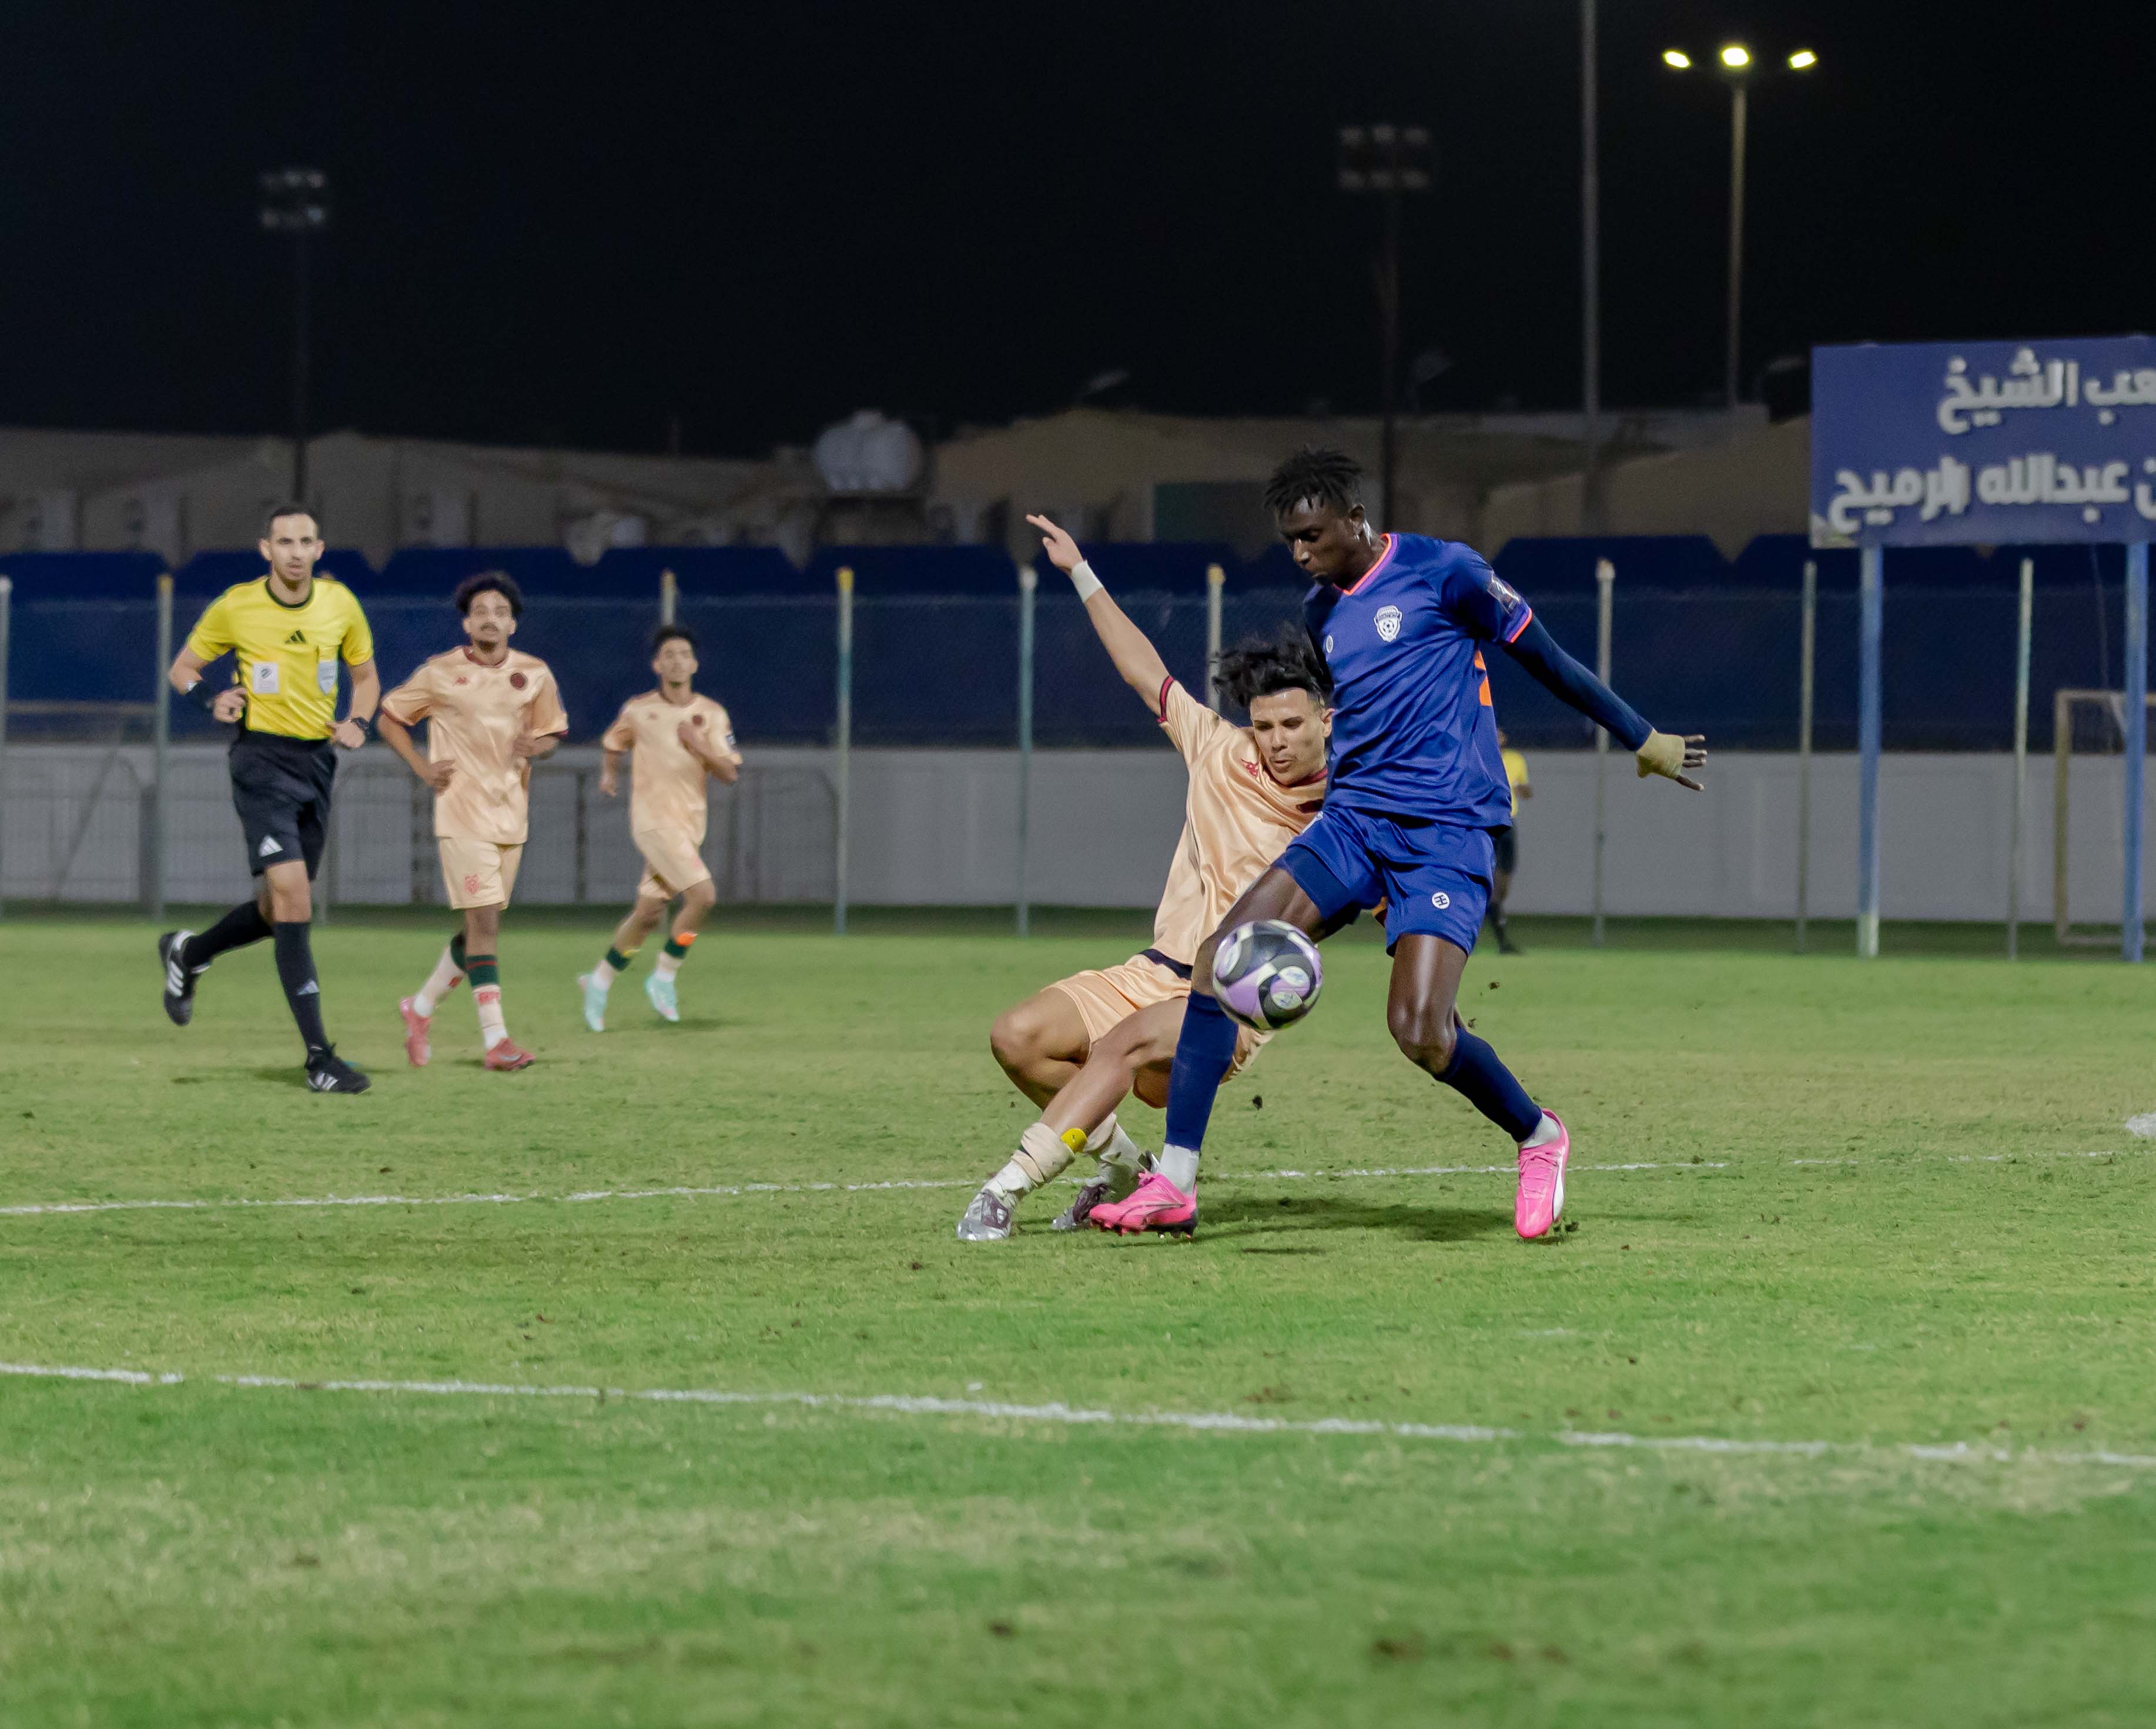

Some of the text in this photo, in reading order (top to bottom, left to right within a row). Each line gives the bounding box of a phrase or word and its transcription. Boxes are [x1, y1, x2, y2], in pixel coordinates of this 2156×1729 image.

[1938, 347, 2156, 434] عب الشيخ
[1977, 453, 2130, 523] عبدالله
